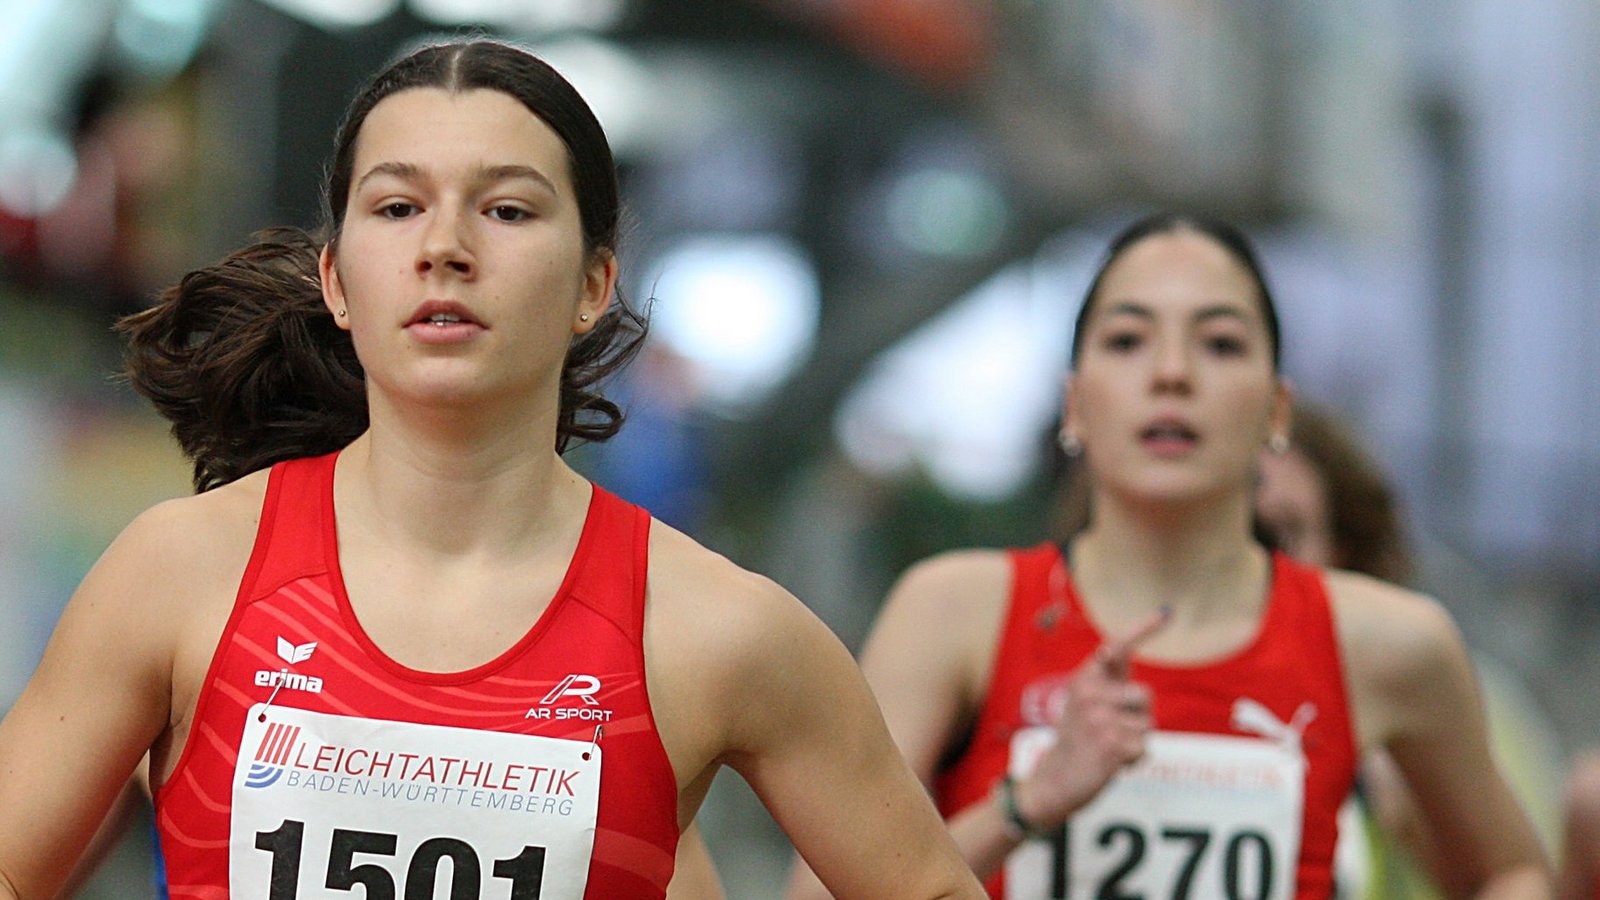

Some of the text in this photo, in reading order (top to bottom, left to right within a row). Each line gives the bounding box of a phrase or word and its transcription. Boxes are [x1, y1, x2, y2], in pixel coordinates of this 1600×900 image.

[254, 668, 323, 694] erima
[524, 708, 613, 721] AR SPORT
[295, 742, 581, 797] LEICHTATHLETIK
[286, 770, 574, 817] BADEN-WÜRTTEMBERG
[254, 818, 547, 900] 1501
